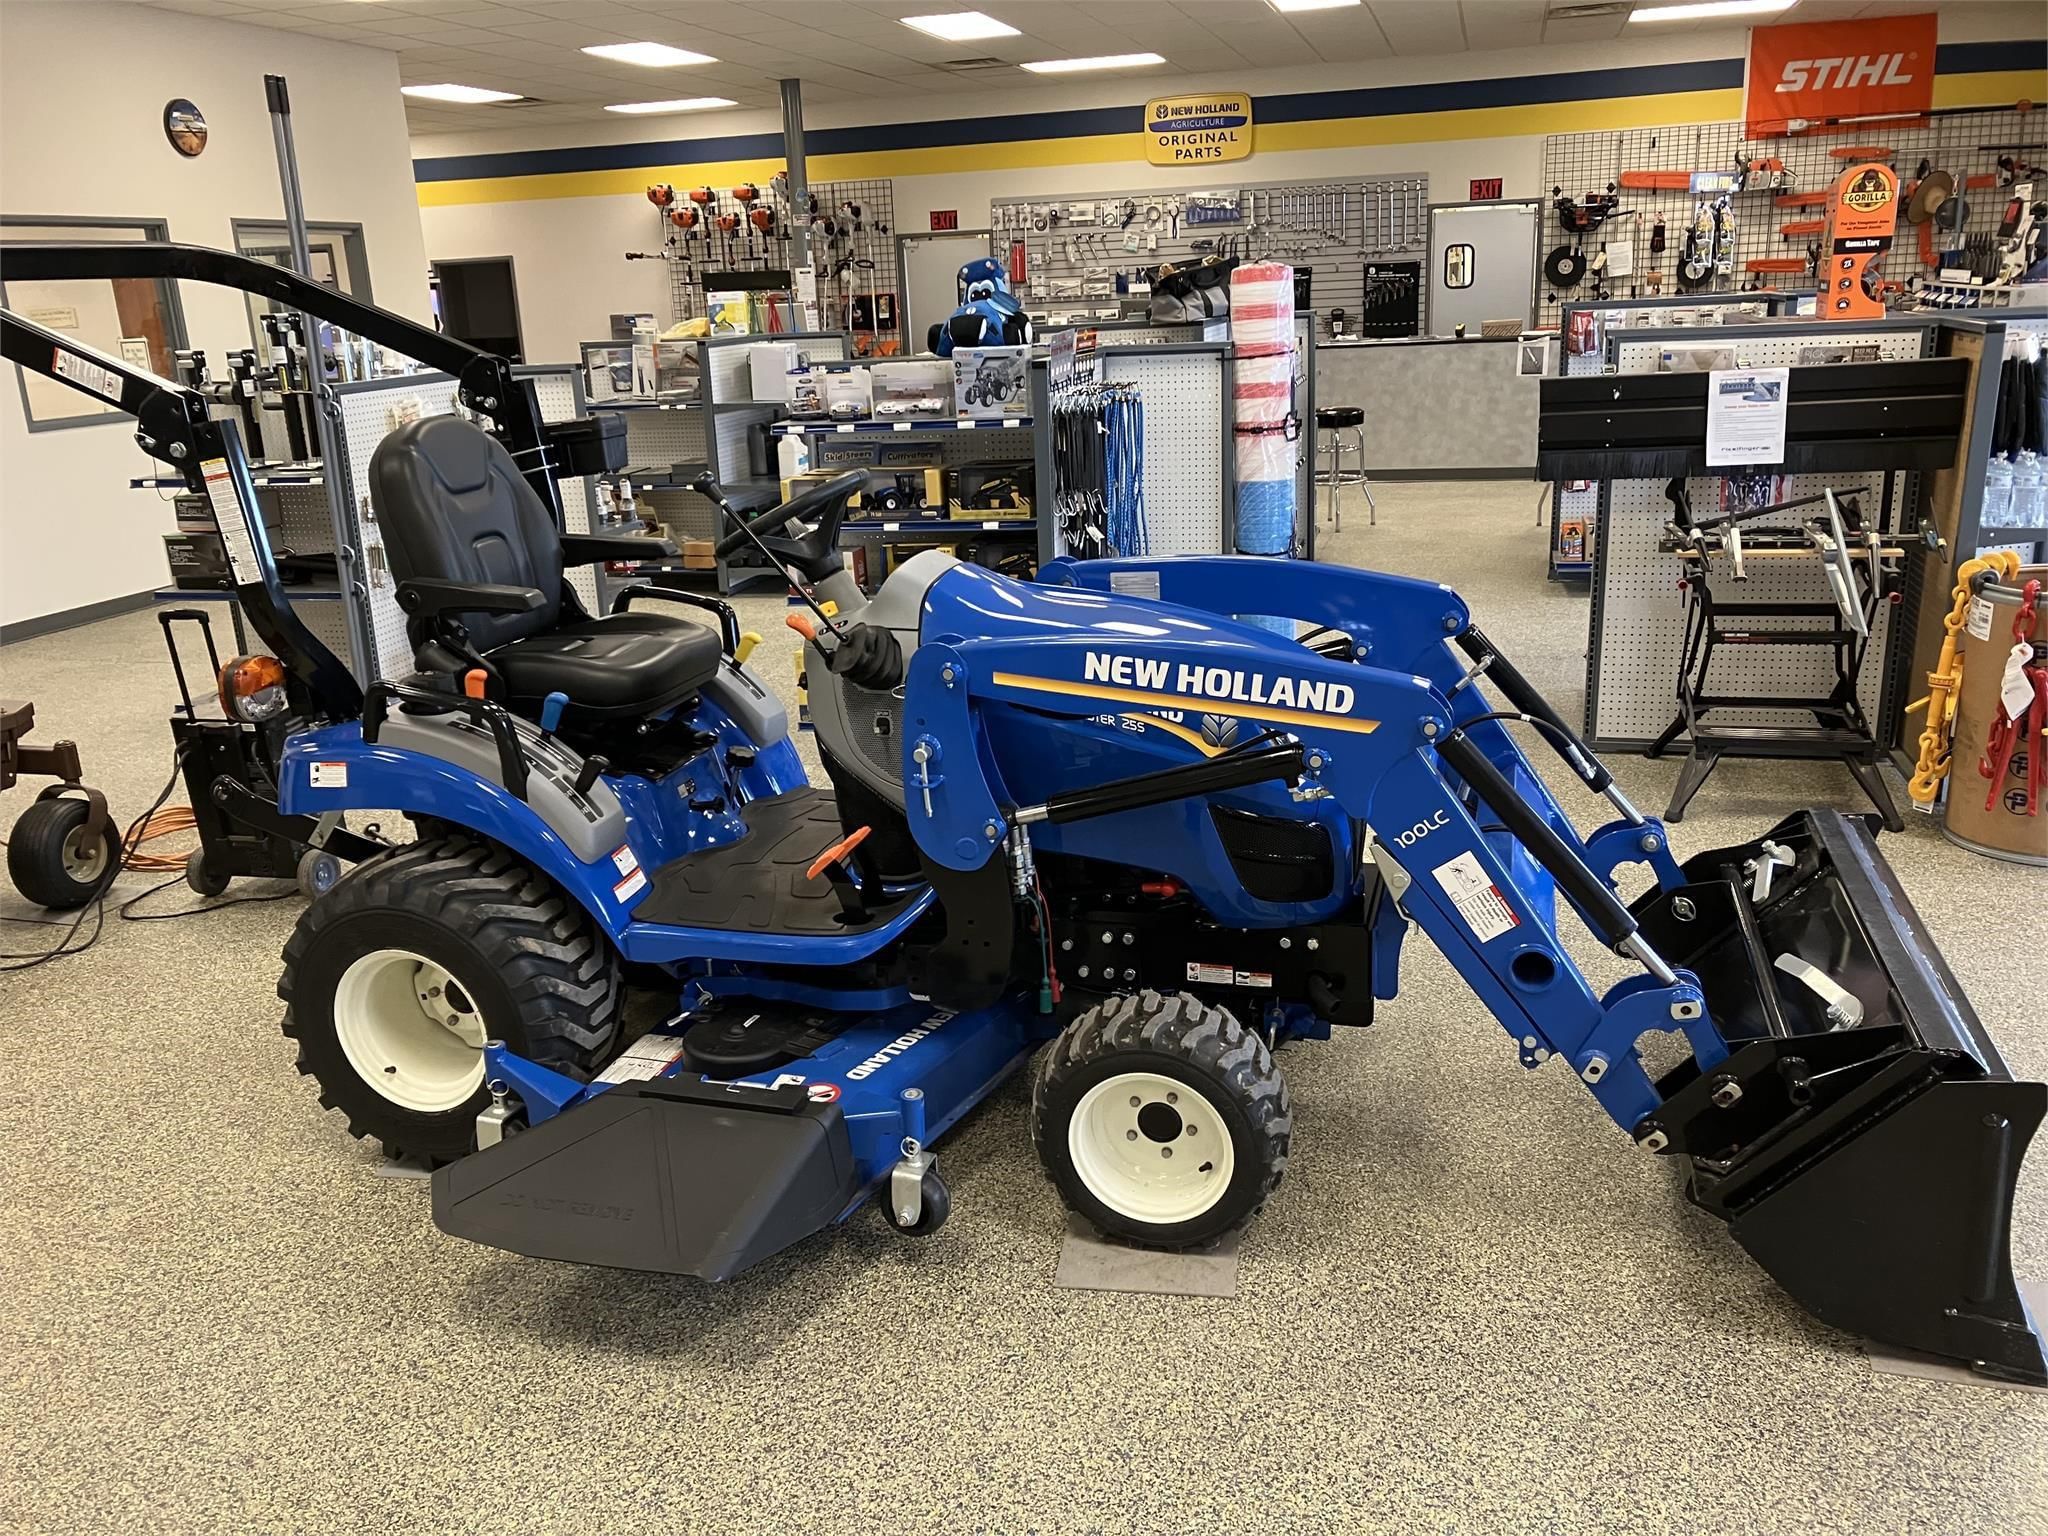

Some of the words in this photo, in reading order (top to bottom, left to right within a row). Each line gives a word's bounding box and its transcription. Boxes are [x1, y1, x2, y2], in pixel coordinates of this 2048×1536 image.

[1774, 53, 1913, 93] STIHL
[1171, 106, 1193, 116] NEW
[1195, 103, 1240, 114] HOLLAND
[1170, 117, 1225, 129] AGRICULTURE
[1158, 131, 1238, 147] ORIGINAL
[1175, 146, 1222, 160] PARTS
[1471, 180, 1501, 200] EXIT
[1848, 192, 1887, 204] GORILLA
[931, 210, 957, 229] EXIT
[825, 452, 843, 462] Skid
[845, 450, 872, 460] Steers
[1084, 651, 1170, 689] NEW
[1176, 664, 1356, 714] HOLLAND
[1121, 717, 1146, 733] 25S
[1393, 809, 1450, 849] 100LC
[845, 1027, 931, 1080] HOLLAND
